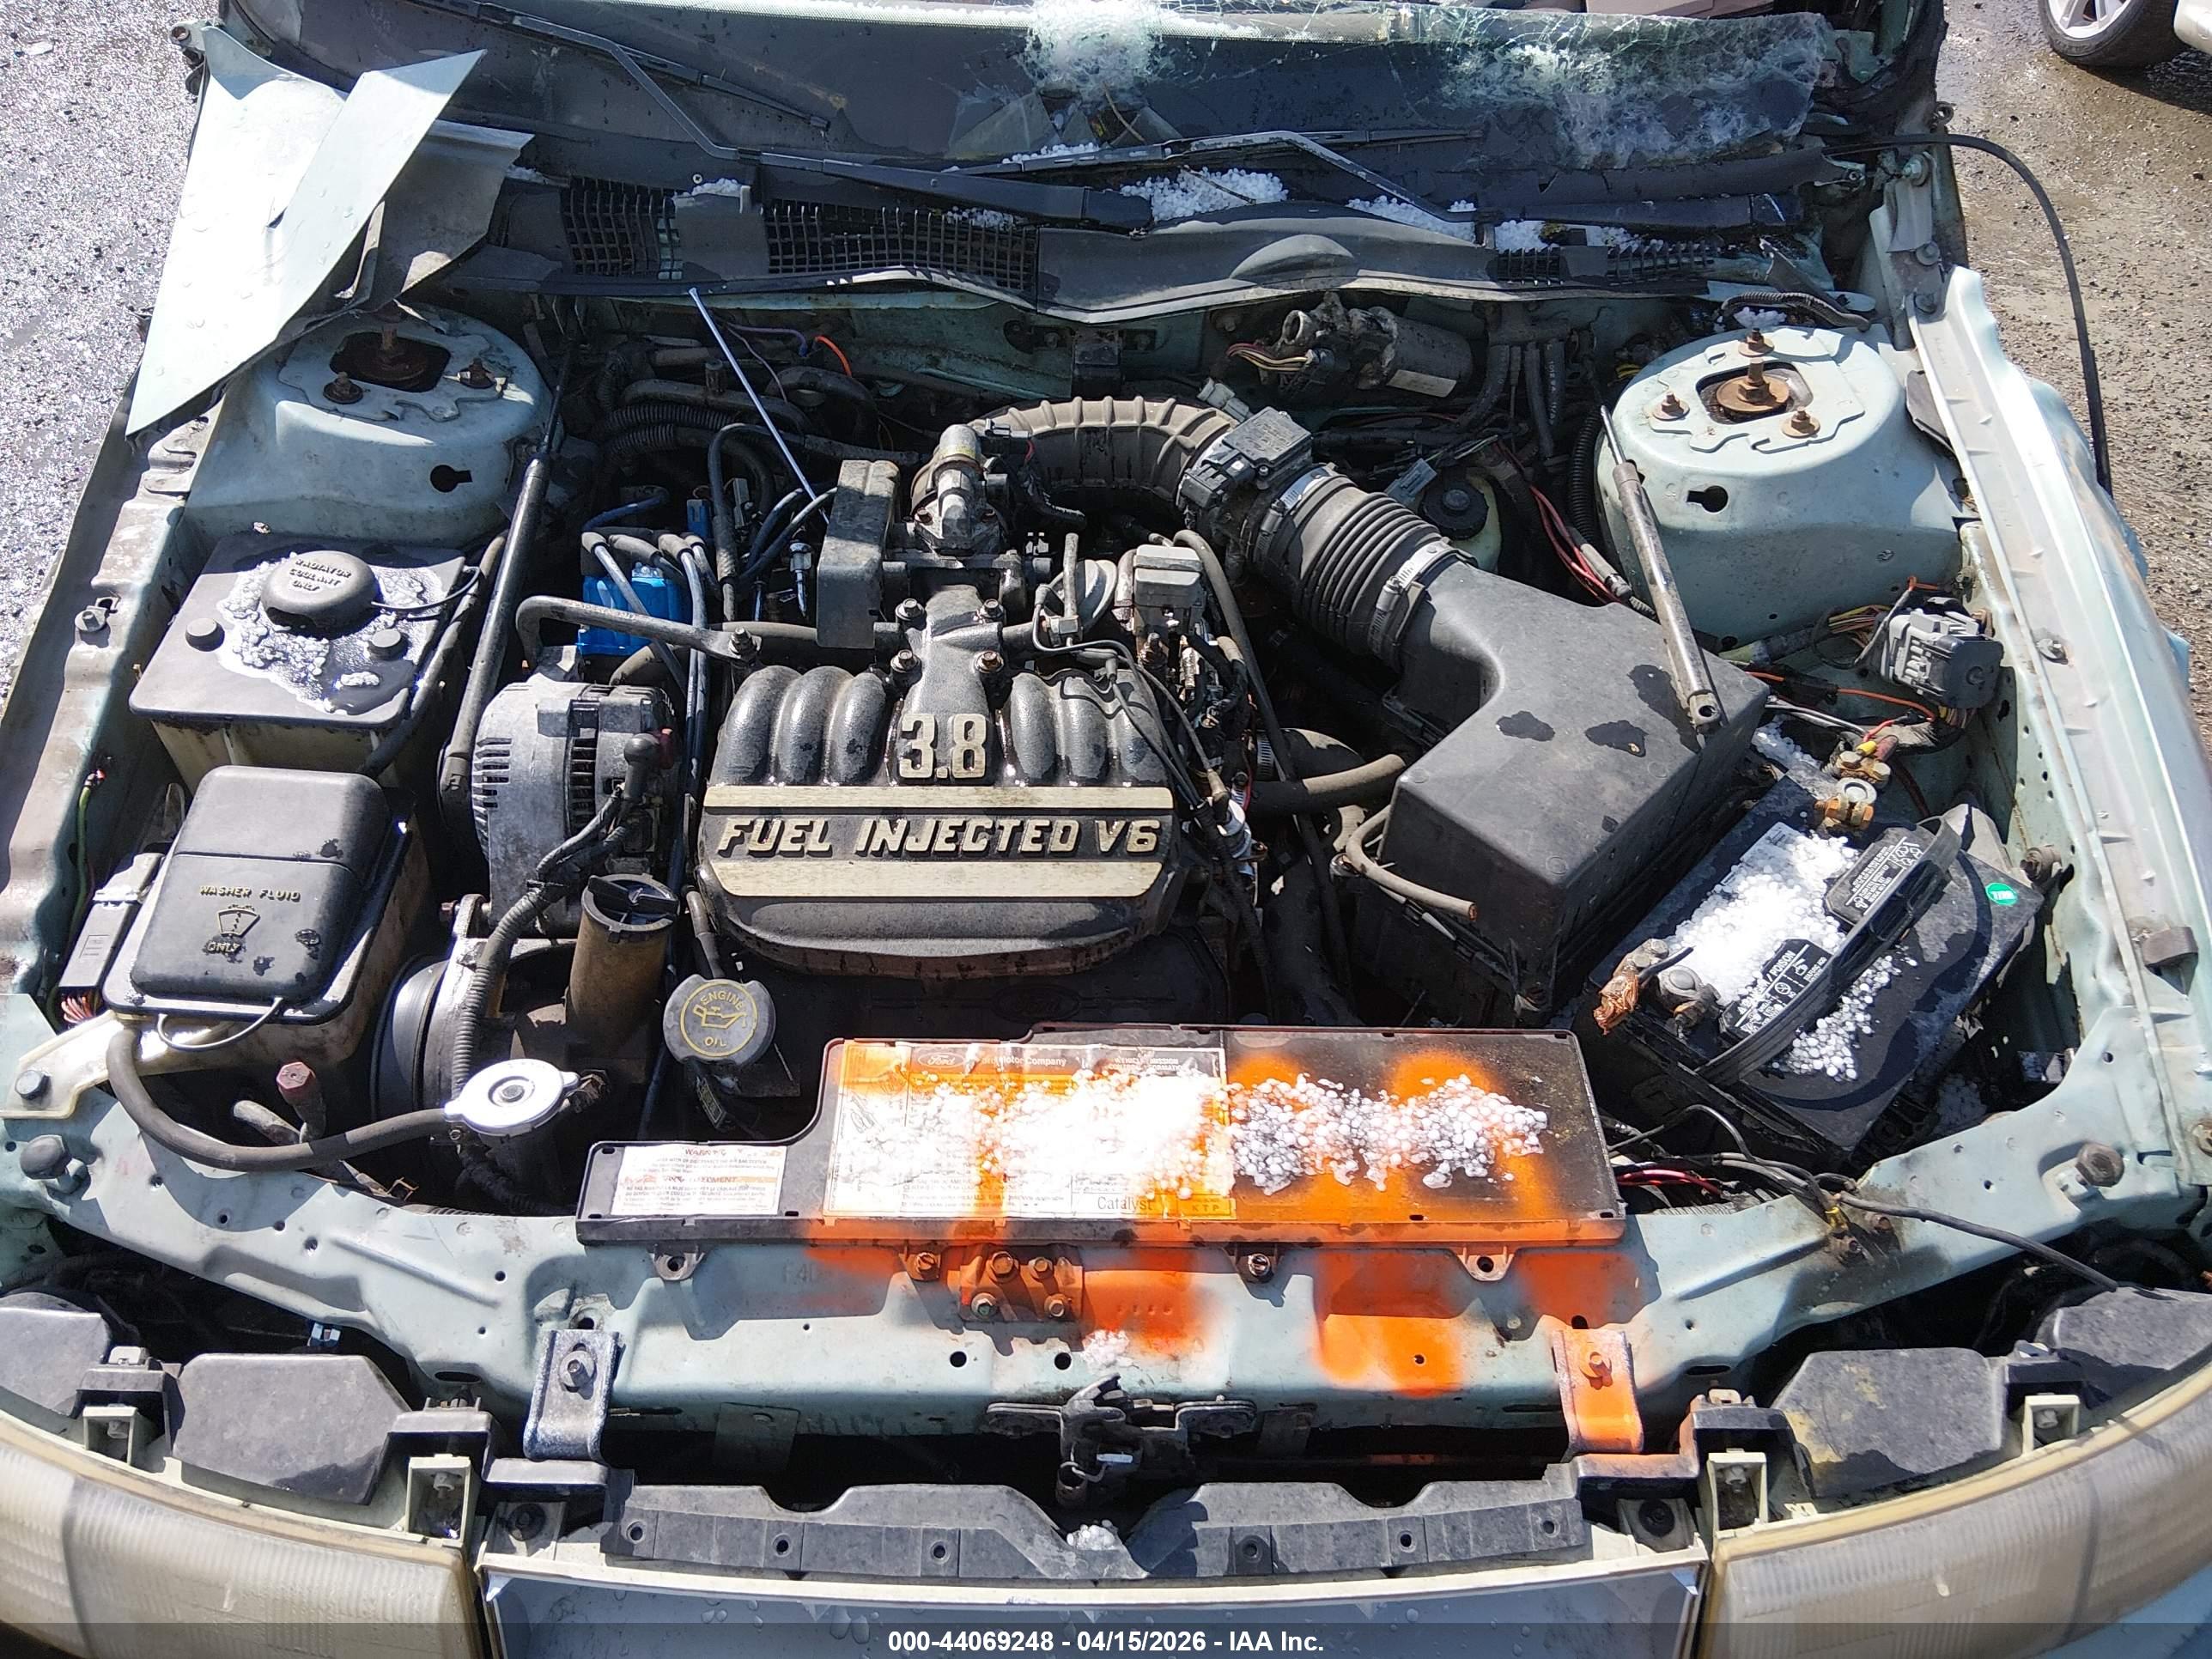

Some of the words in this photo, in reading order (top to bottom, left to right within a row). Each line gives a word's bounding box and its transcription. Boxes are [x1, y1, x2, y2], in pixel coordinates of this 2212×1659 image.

[295, 558, 352, 578] RADIATOR
[289, 568, 342, 586] COOLANT
[292, 580, 320, 591] ONLY
[899, 714, 987, 779] 3.8
[716, 818, 831, 854] FUEL
[856, 818, 1081, 853] INJECTED
[1096, 819, 1162, 853] V6
[199, 885, 252, 898] WASHER
[259, 889, 301, 902] FLUID
[207, 941, 241, 953] ONLY
[1770, 950, 1796, 977] POISON
[700, 990, 744, 1011] ENGINE
[704, 1036, 727, 1047] OIL
[927, 1054, 956, 1066] Ford
[1025, 1056, 1067, 1067] Company
[1097, 1195, 1152, 1211] Catalyst
